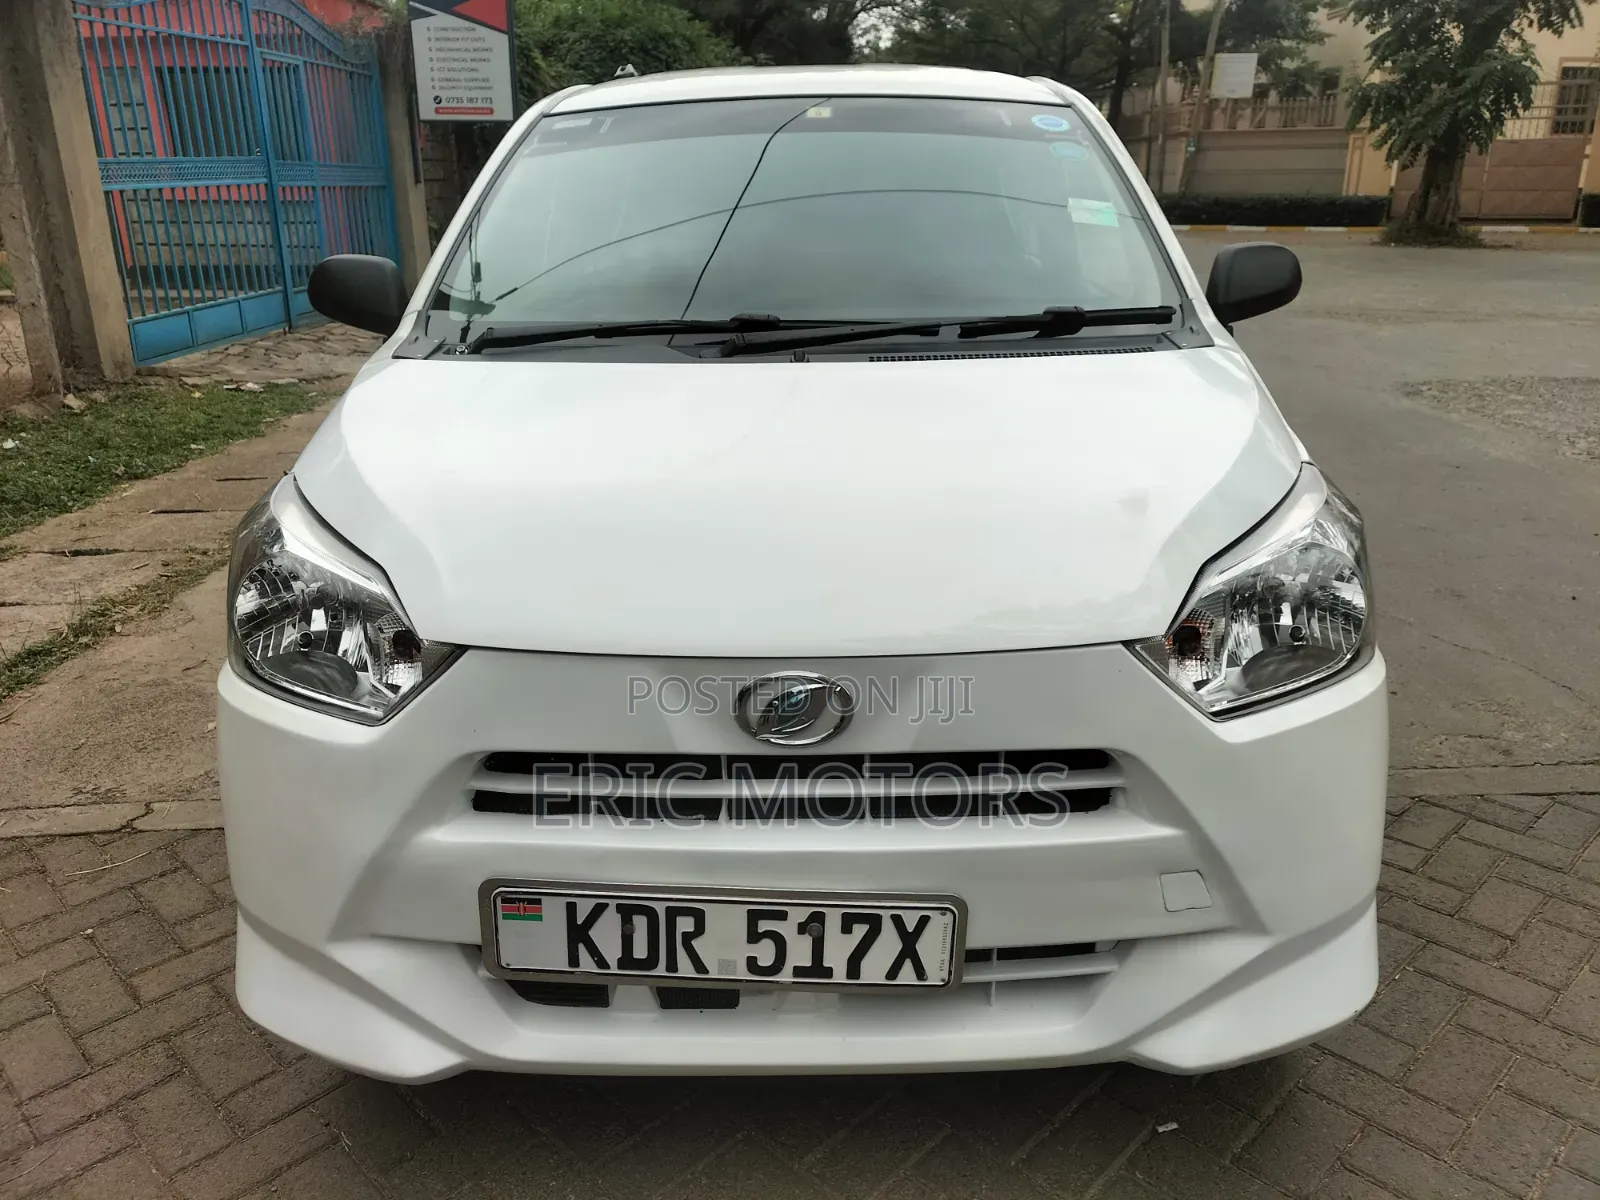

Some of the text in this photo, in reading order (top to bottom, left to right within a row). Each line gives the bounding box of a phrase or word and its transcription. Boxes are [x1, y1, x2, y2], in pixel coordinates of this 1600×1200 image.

[445, 96, 493, 104] 0735 187 173
[566, 901, 932, 981] KDR 517X
